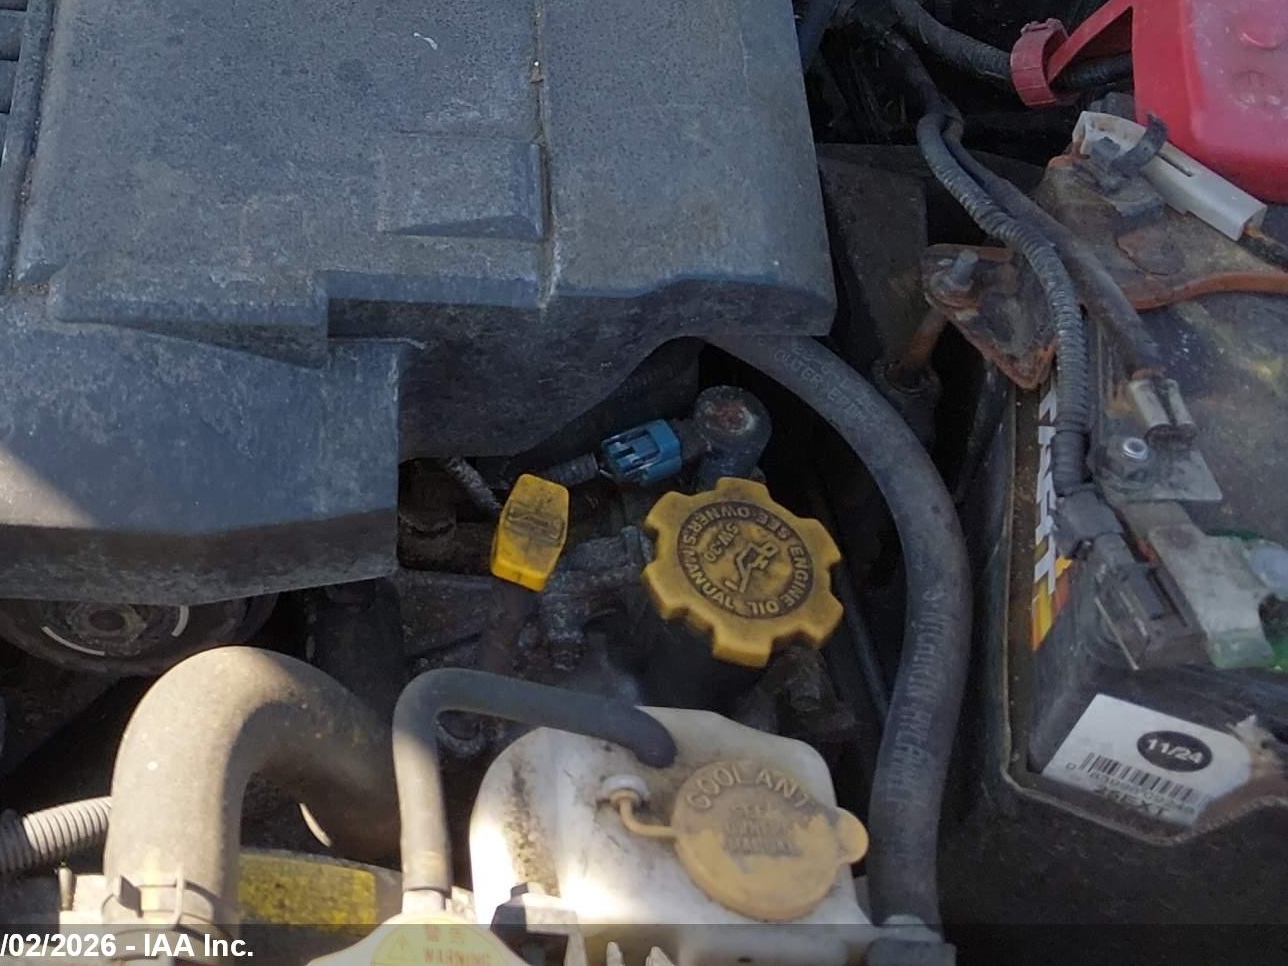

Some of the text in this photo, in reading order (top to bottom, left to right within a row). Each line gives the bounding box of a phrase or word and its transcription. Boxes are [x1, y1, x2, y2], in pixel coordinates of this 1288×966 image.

[754, 512, 791, 540] SEE
[746, 545, 810, 616] ENGINE OIL
[1147, 737, 1203, 766] 11/24
